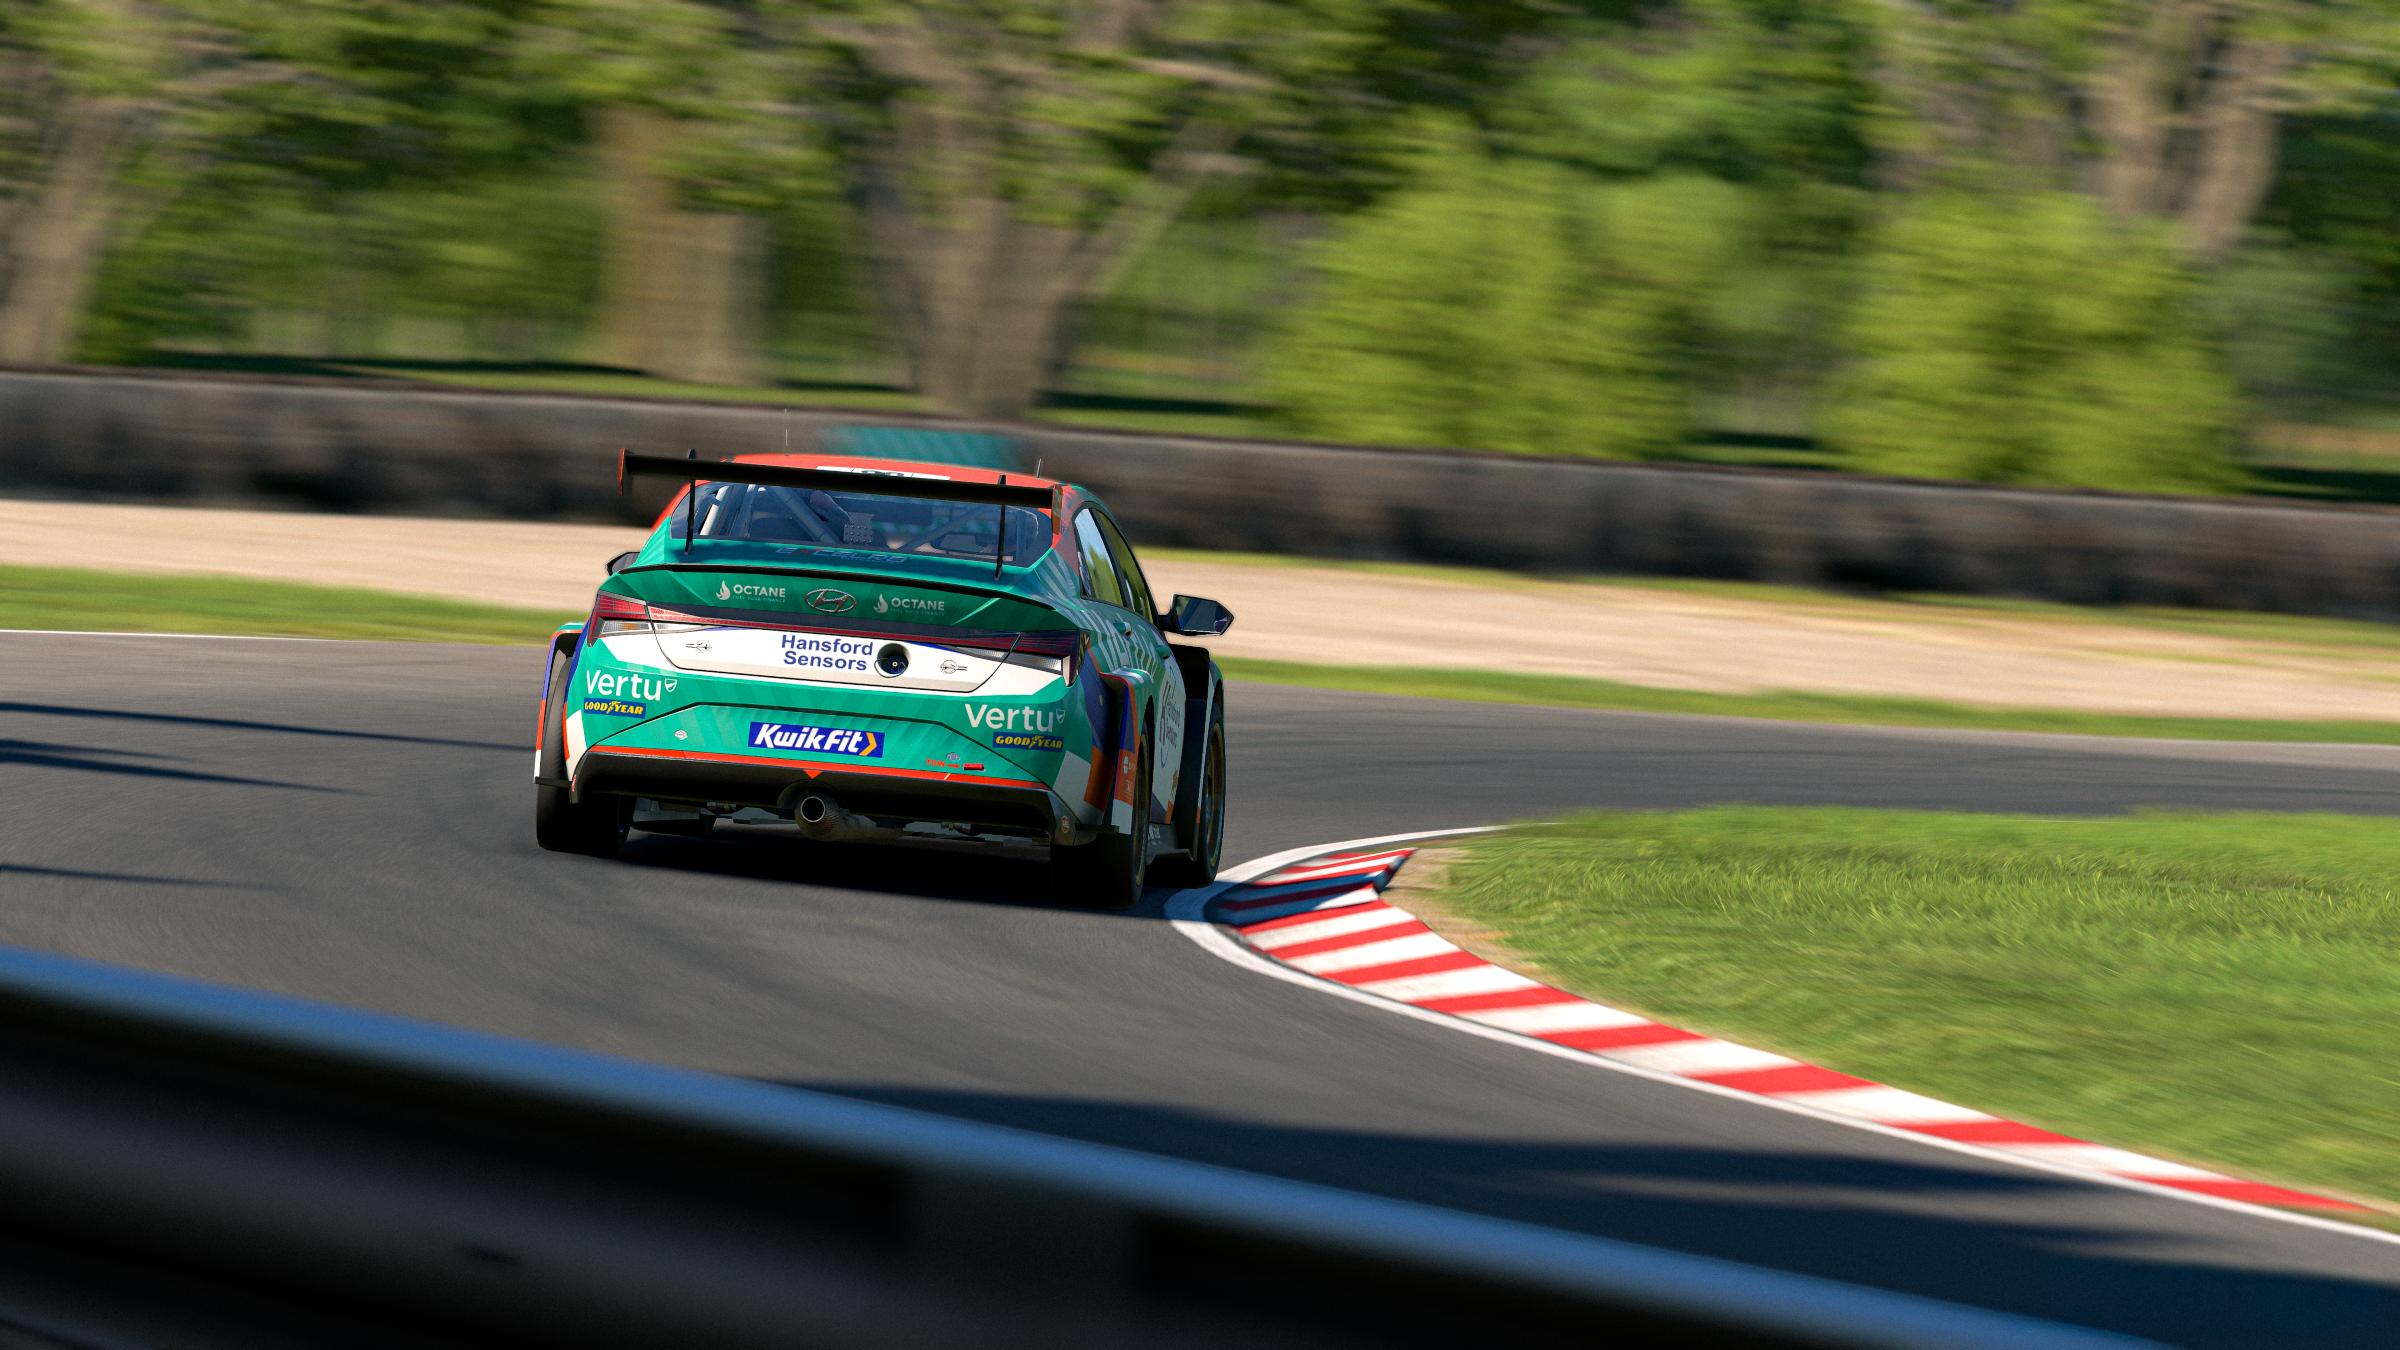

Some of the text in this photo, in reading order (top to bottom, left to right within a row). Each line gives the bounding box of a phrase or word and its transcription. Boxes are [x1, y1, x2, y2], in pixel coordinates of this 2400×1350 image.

[733, 584, 786, 598] OCTANE
[891, 597, 945, 611] OCTANE
[781, 634, 874, 656] Hansford
[783, 650, 867, 671] Sensors
[586, 669, 662, 701] Vertu
[584, 701, 644, 715] GOODYEAR
[964, 703, 1054, 732] Vertu
[995, 735, 1063, 749] GOODYEAR
